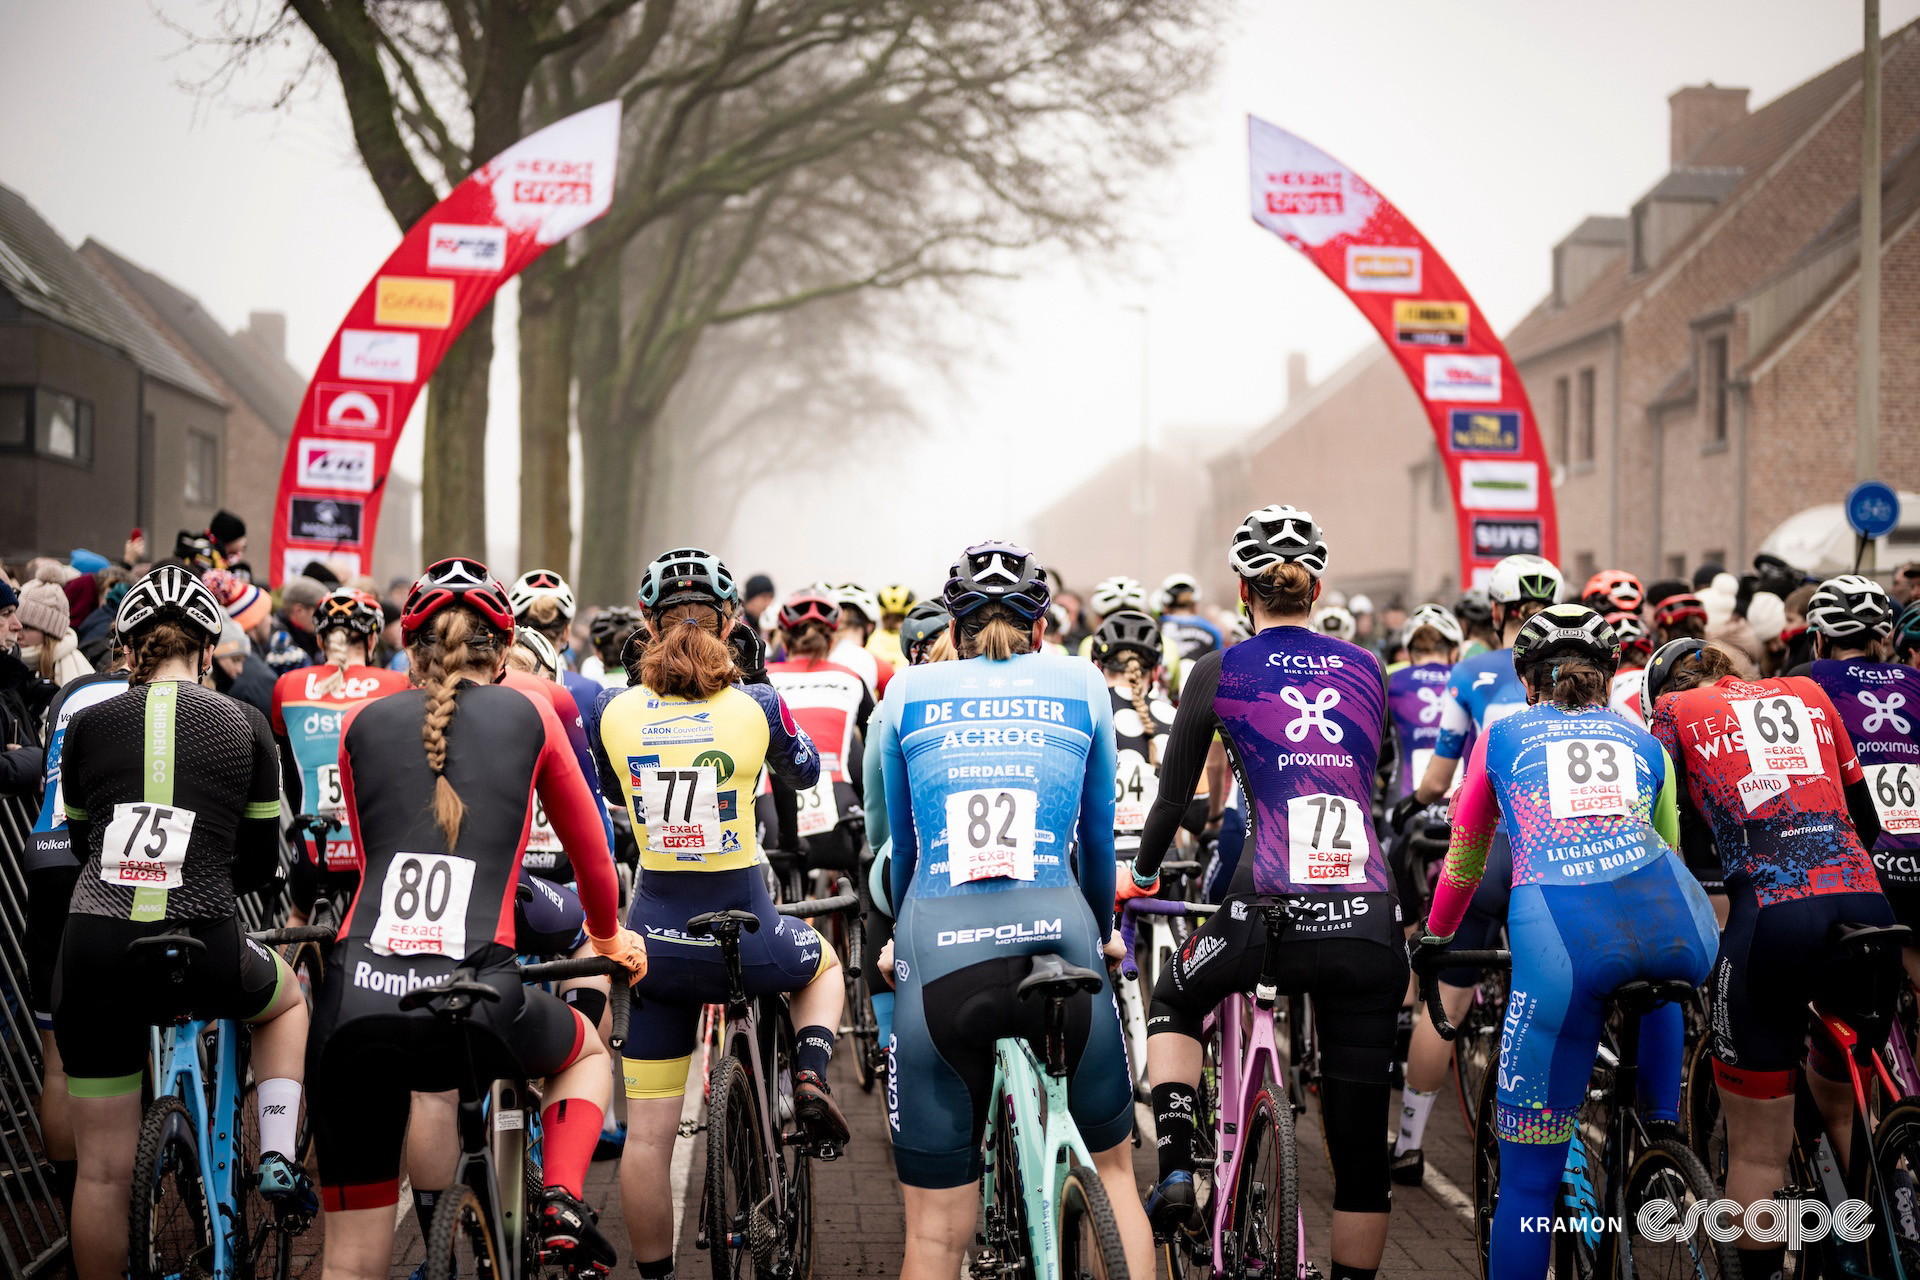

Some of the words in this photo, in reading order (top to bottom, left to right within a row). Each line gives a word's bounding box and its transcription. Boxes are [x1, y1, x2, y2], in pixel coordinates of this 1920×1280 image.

[1475, 525, 1539, 549] SUYS
[129, 609, 149, 624] LAZER
[190, 610, 210, 625] LAZER
[924, 701, 954, 725] DE
[960, 699, 1066, 723] CEUSTER
[1753, 698, 1800, 745] 63
[152, 702, 168, 756] SHIBDEN
[641, 727, 672, 735] CARON
[673, 726, 714, 735] Couverture
[1547, 723, 1615, 732] SILVA
[1686, 714, 1741, 741] TEA
[939, 727, 1047, 751] ACROG
[1856, 741, 1920, 756] proximus
[152, 759, 167, 784] CC
[947, 764, 1035, 779] DERDAELE
[1277, 752, 1354, 771] proximus
[1566, 741, 1620, 785] 83
[1768, 758, 1806, 769] cross
[1740, 779, 1782, 794] BAIRD
[1876, 765, 1916, 808] 66
[657, 771, 699, 824] 77
[1573, 797, 1620, 810] cross
[967, 792, 1017, 849] 82
[1307, 796, 1352, 851] 72
[1780, 824, 1836, 838] BONTRAGER
[123, 805, 174, 859] 75
[664, 836, 704, 848] cross
[1547, 831, 1647, 862] LUGAGNANO
[1310, 865, 1348, 877] cross
[1561, 860, 1595, 877] OFF
[1598, 846, 1646, 872] ROAD
[1872, 851, 1920, 877] CYCL
[121, 867, 166, 881] cross
[1888, 873, 1906, 882] BIKE
[394, 857, 452, 922] 80
[137, 904, 163, 913] AMG
[937, 917, 1062, 947] DEPOLIM
[1295, 923, 1318, 932] BIKE
[1321, 921, 1353, 931] LEASE
[388, 940, 441, 953] cross
[995, 933, 1062, 946] MOTORHOMES
[1511, 1055, 1519, 1072] THE
[1515, 1023, 1529, 1052] LIVING
[1526, 997, 1538, 1021] EDGE
[888, 1032, 901, 1133] ACROG
[1158, 1111, 1194, 1123] proxim
